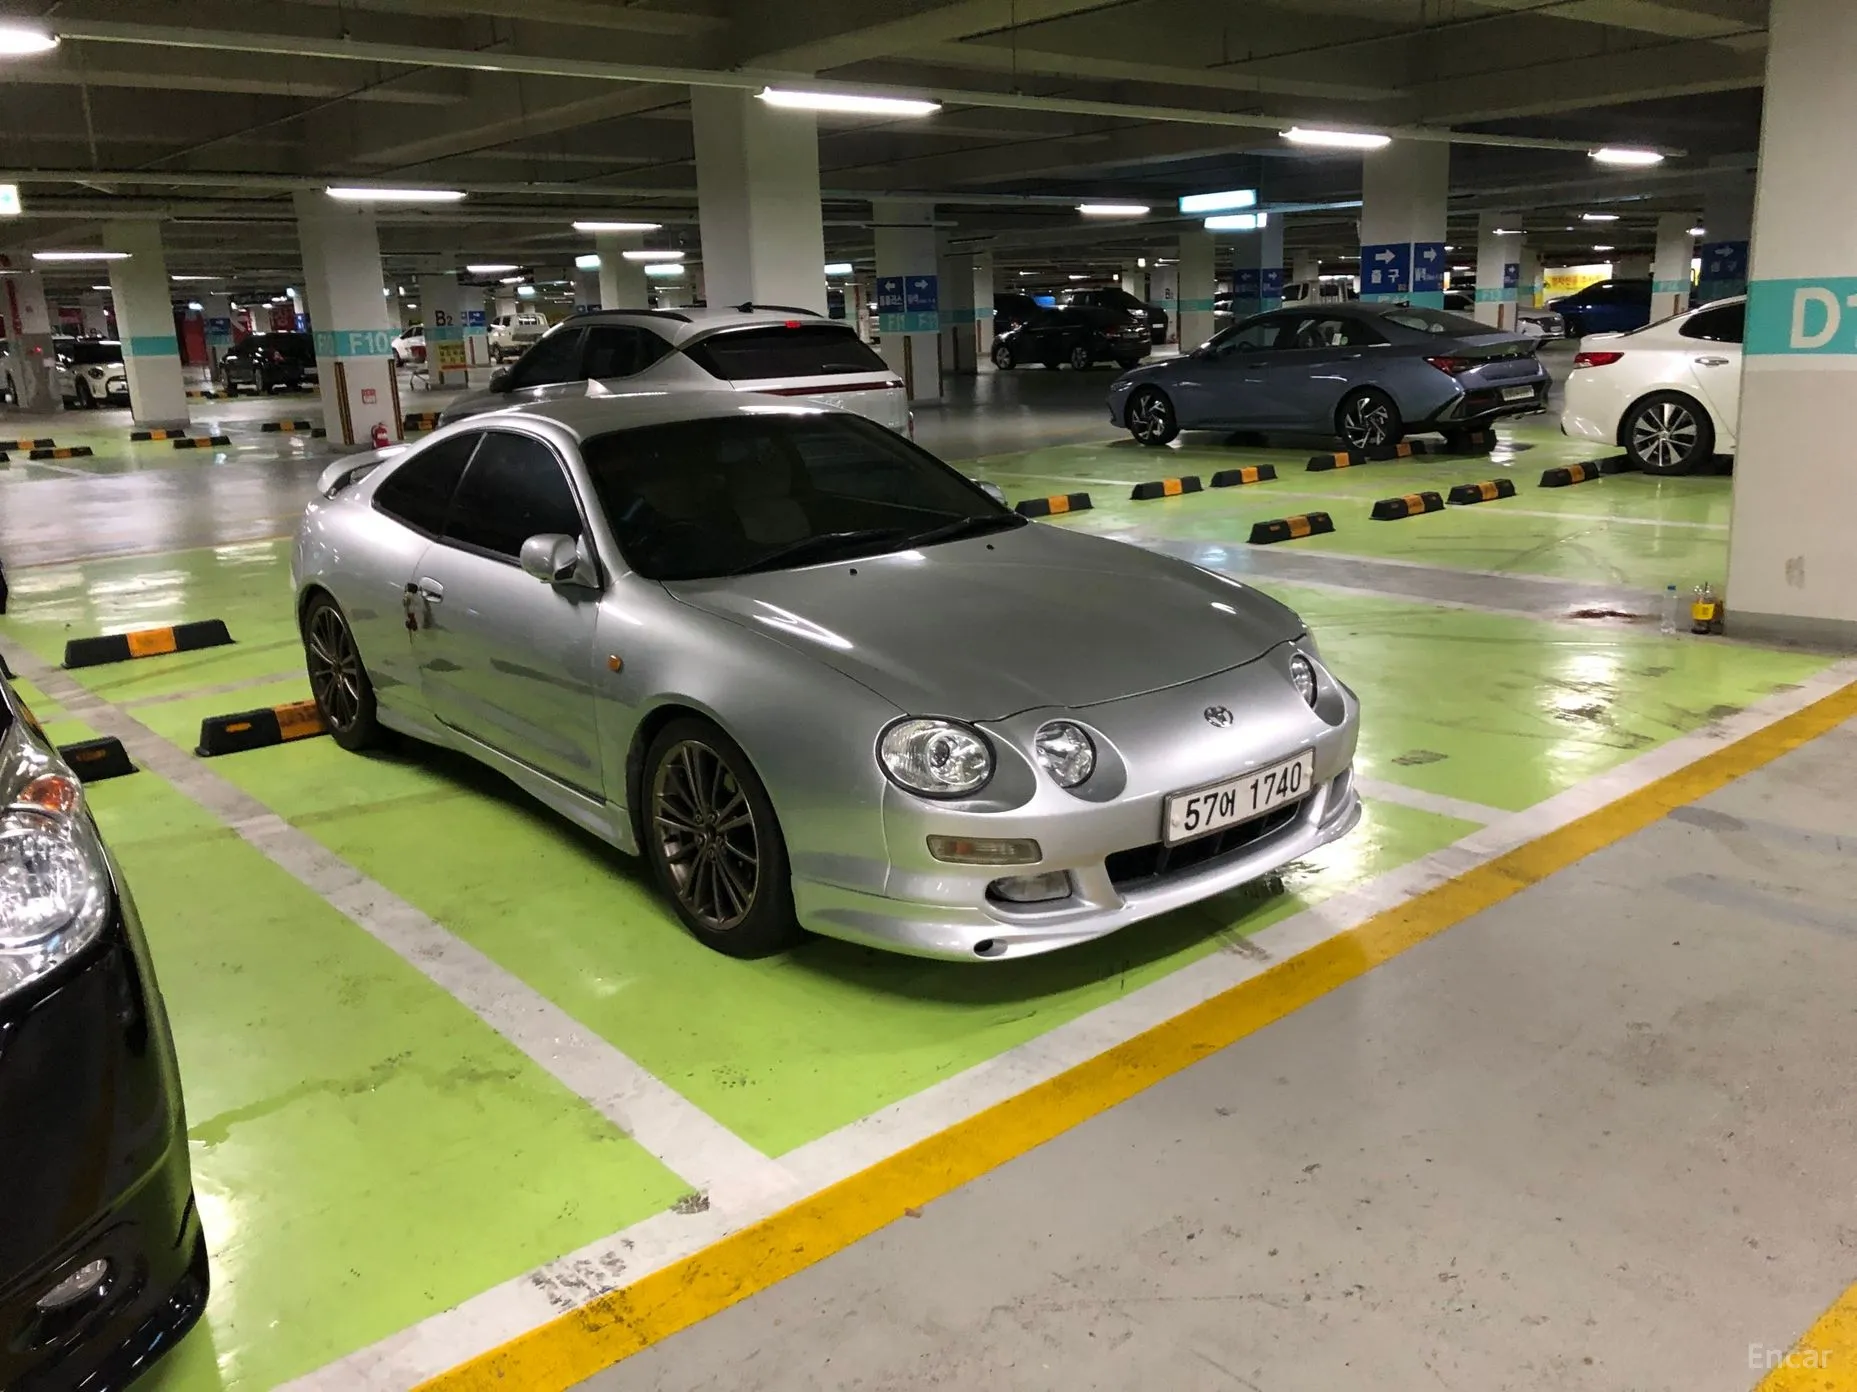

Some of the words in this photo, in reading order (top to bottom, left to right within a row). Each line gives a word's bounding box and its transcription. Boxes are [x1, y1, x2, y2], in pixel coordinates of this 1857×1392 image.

[435, 310, 453, 326] B2
[349, 331, 389, 355] F10
[1184, 788, 1236, 831] 57어
[1250, 761, 1302, 810] 1740
